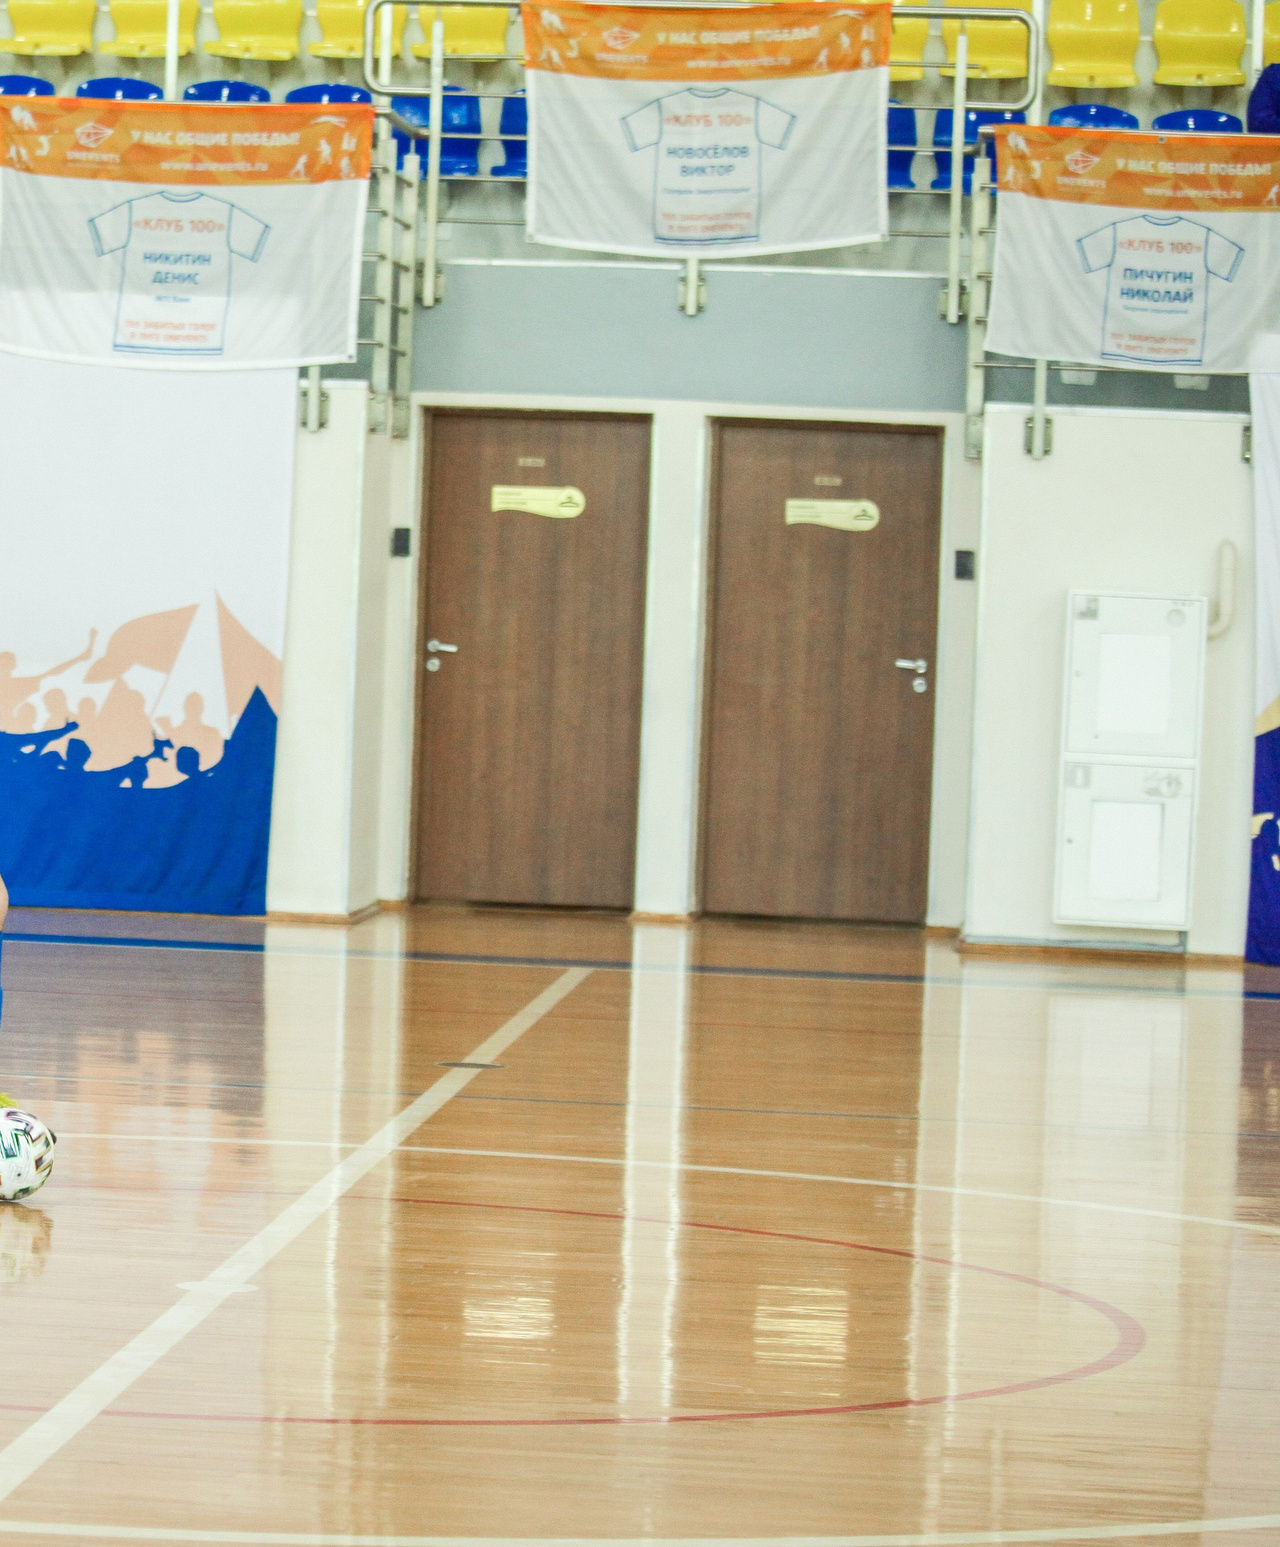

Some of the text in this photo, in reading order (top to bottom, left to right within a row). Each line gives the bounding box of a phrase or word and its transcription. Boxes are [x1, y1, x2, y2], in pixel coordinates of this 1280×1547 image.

[657, 31, 668, 44] У
[670, 31, 697, 45] НАС
[700, 30, 751, 45] ОБЩИЕ
[131, 129, 141, 143] У
[143, 130, 173, 145] НАС
[176, 131, 228, 147] ОБЩИЕ
[680, 164, 735, 177] ВИКТОР
[1116, 158, 1126, 170] У
[1128, 160, 1155, 173] НАС
[1157, 161, 1206, 175] ОБЩИЕ
[143, 252, 212, 266] НИКИТИН
[152, 271, 200, 285] ДЕНИС
[1123, 268, 1193, 283] ПИЧУГИН
[1120, 288, 1193, 303] НИКОЛАЙ
